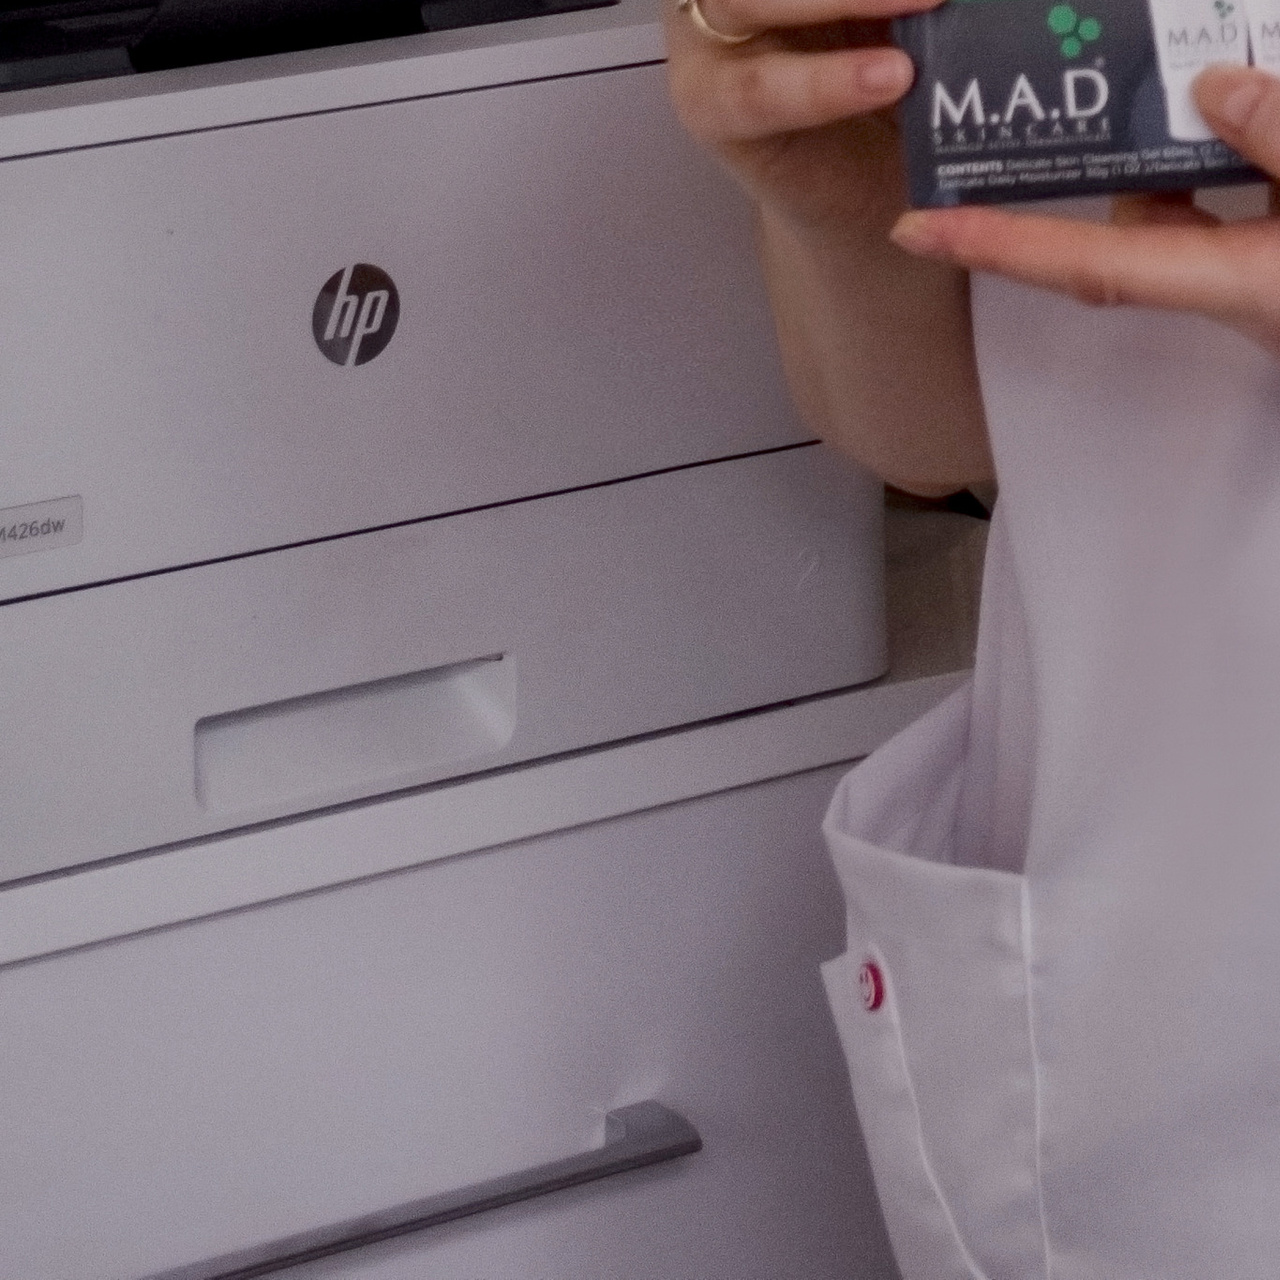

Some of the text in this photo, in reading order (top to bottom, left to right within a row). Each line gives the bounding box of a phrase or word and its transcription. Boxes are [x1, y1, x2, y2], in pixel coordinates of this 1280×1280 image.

[1168, 22, 1239, 47] M.A.D
[931, 68, 1109, 129] M.A.D
[937, 159, 1003, 177] CONTENTS
[1006, 158, 1053, 172] Delicate
[1055, 155, 1080, 168] Skin
[1082, 151, 1138, 167] Cleansing
[938, 176, 985, 190] Delicate
[988, 173, 1016, 188] Daily
[1019, 169, 1082, 184] Moisturizer
[318, 263, 395, 367] hp
